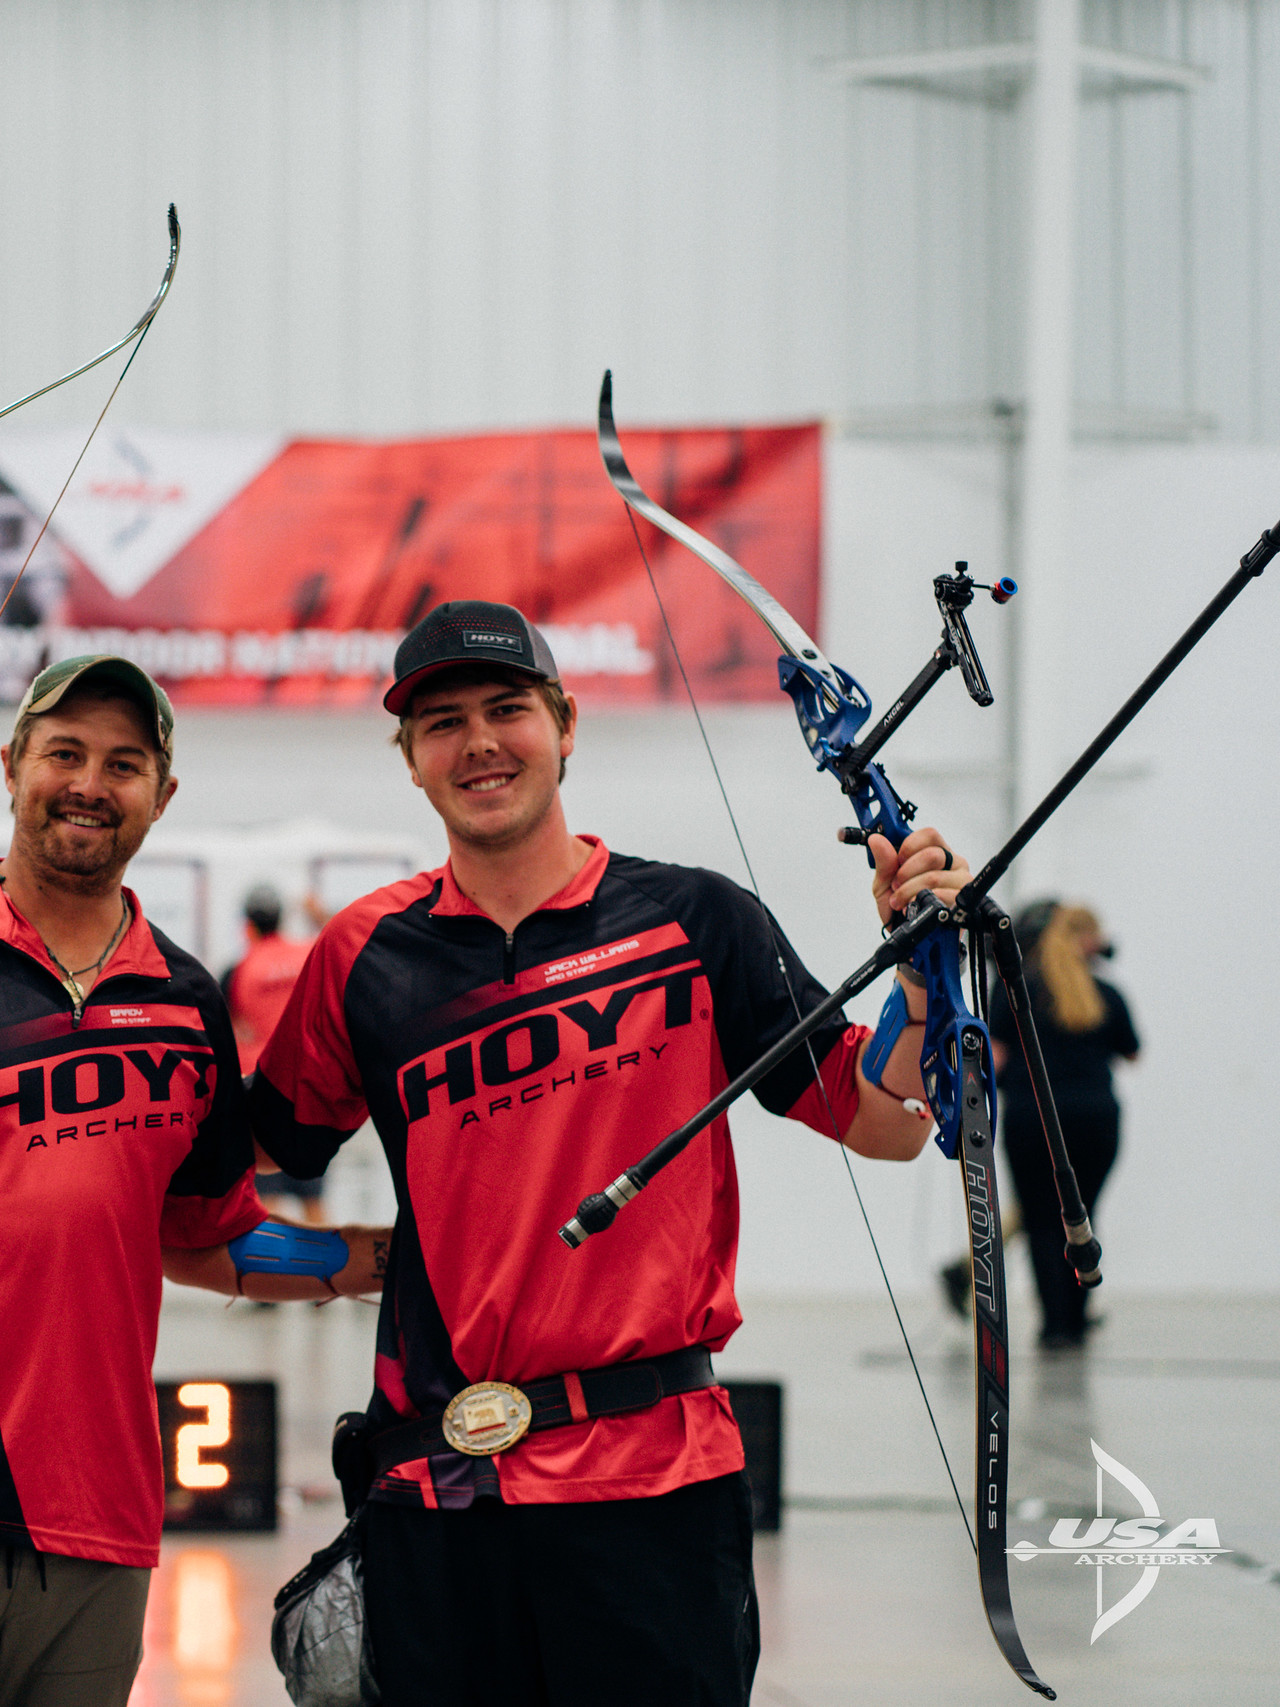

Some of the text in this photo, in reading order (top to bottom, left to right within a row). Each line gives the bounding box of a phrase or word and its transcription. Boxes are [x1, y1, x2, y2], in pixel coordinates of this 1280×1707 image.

[471, 634, 517, 645] HOYT
[544, 939, 639, 976] JACK WILLIAMS
[109, 1008, 144, 1018] BRADY
[403, 964, 705, 1125] HOYT
[460, 1042, 669, 1130] ARCHERY
[965, 1158, 997, 1313] HOYT
[176, 1382, 231, 1488] 2
[987, 1409, 1000, 1530] VELOS
